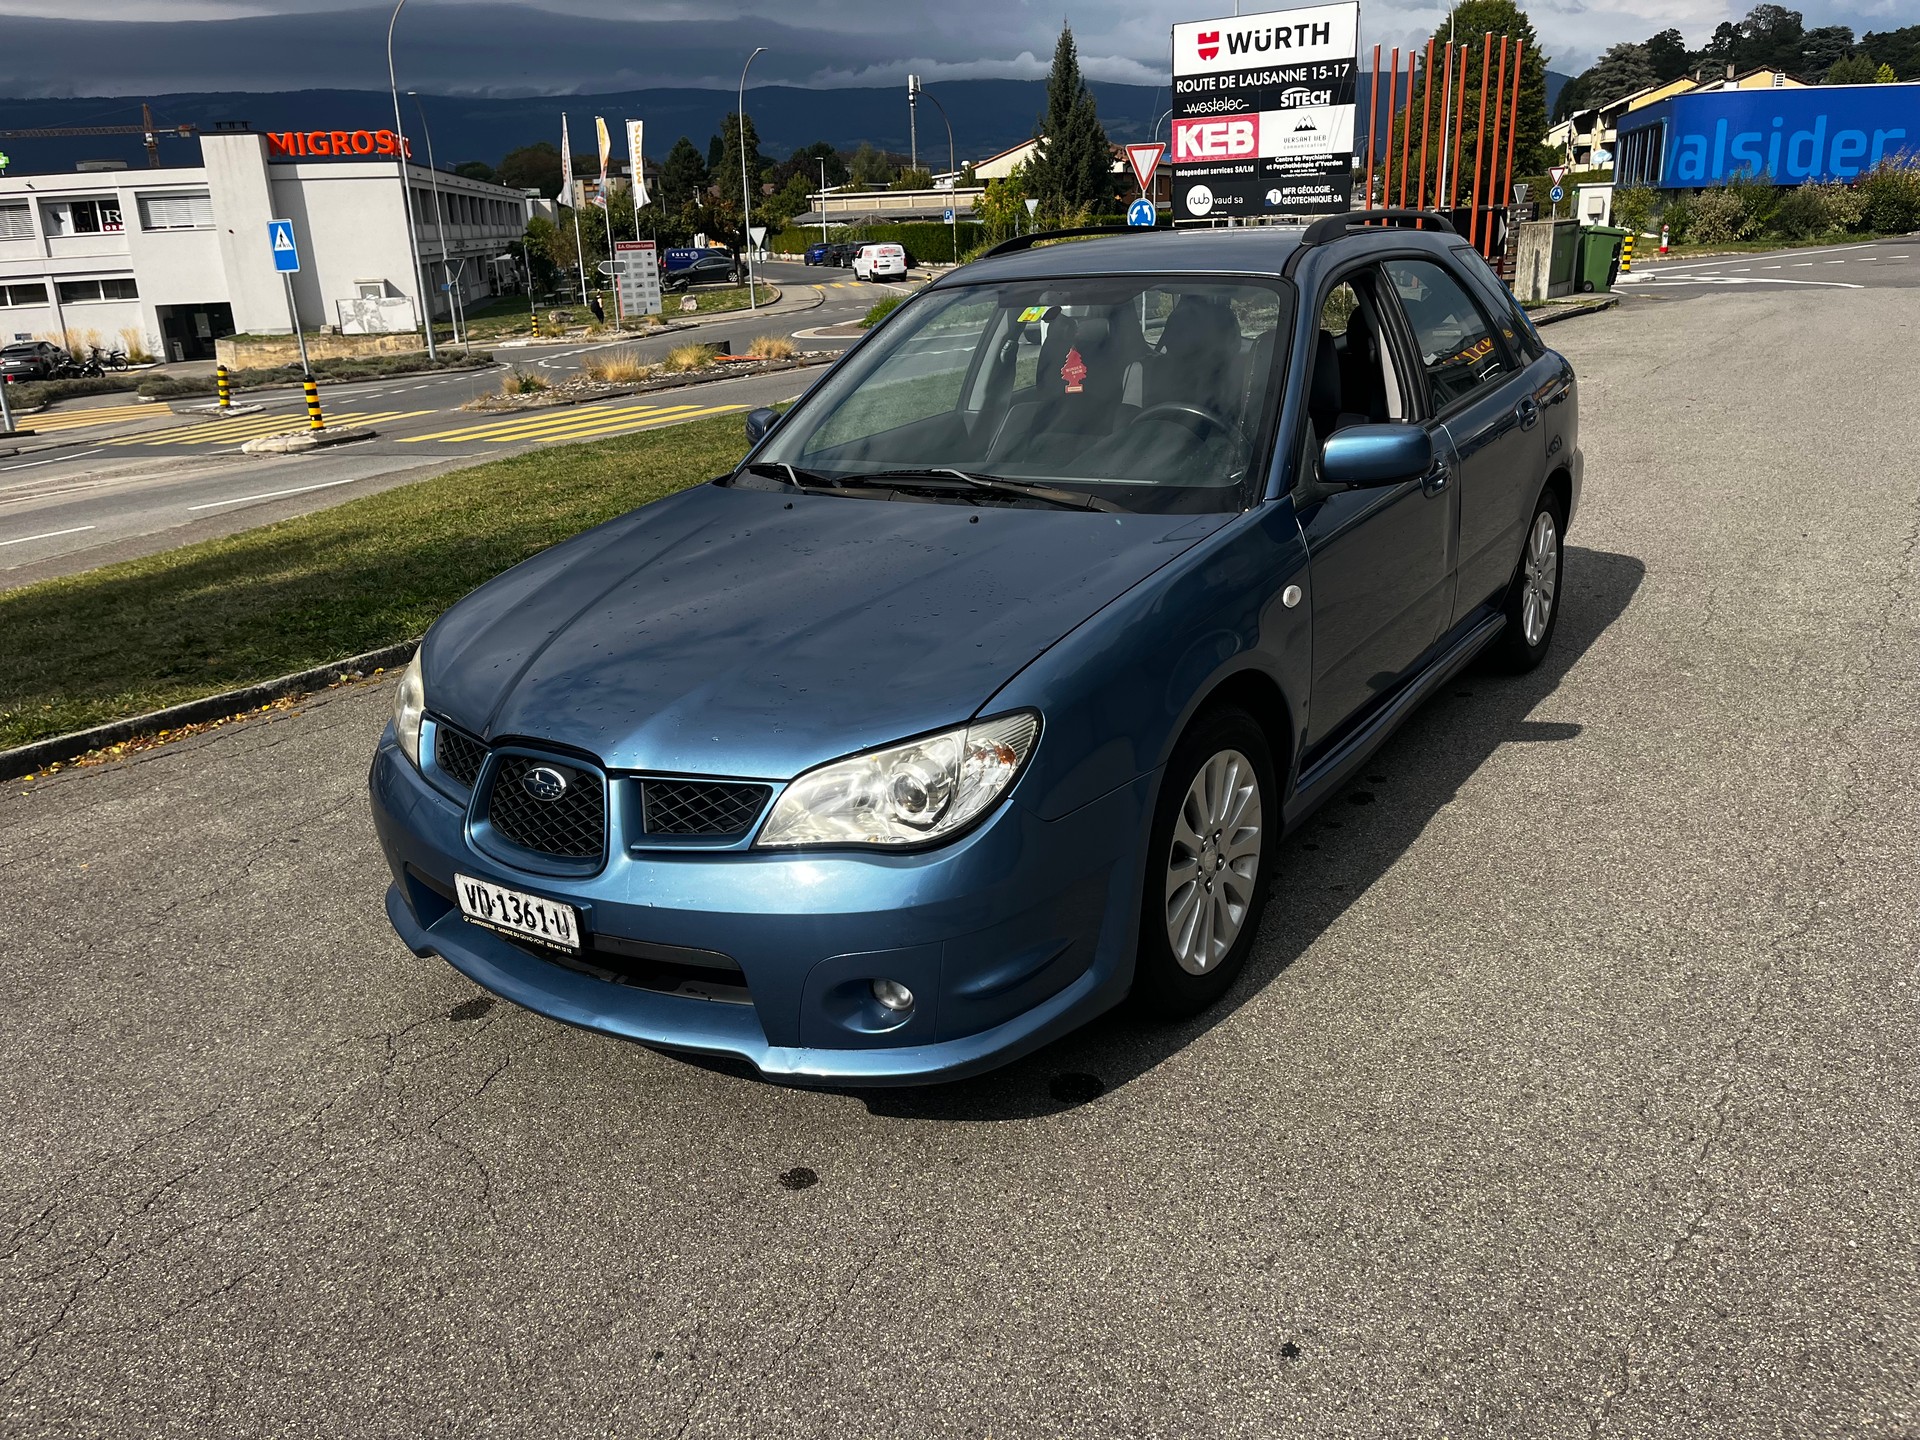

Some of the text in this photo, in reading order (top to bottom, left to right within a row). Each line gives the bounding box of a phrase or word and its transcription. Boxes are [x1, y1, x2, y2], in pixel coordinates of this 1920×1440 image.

[1227, 22, 1330, 55] WÜRTH
[1176, 64, 1350, 94] ROUTE DE LAUSANNE 15-17
[1183, 97, 1250, 115] westelec
[1281, 88, 1332, 108] SITECH
[267, 130, 395, 156] MIGROS
[1177, 121, 1255, 158] KEB
[1284, 136, 1312, 144] VERSANT
[634, 124, 643, 185] MIGROS
[1302, 154, 1333, 162] Psychiatrie
[1235, 165, 1254, 173] SA/Ltd
[1283, 187, 1296, 195] MFR
[1297, 185, 1331, 194] GÉOLOGIE
[1214, 195, 1232, 204] vaud
[1282, 195, 1332, 205] GÉOTECHNIQUE
